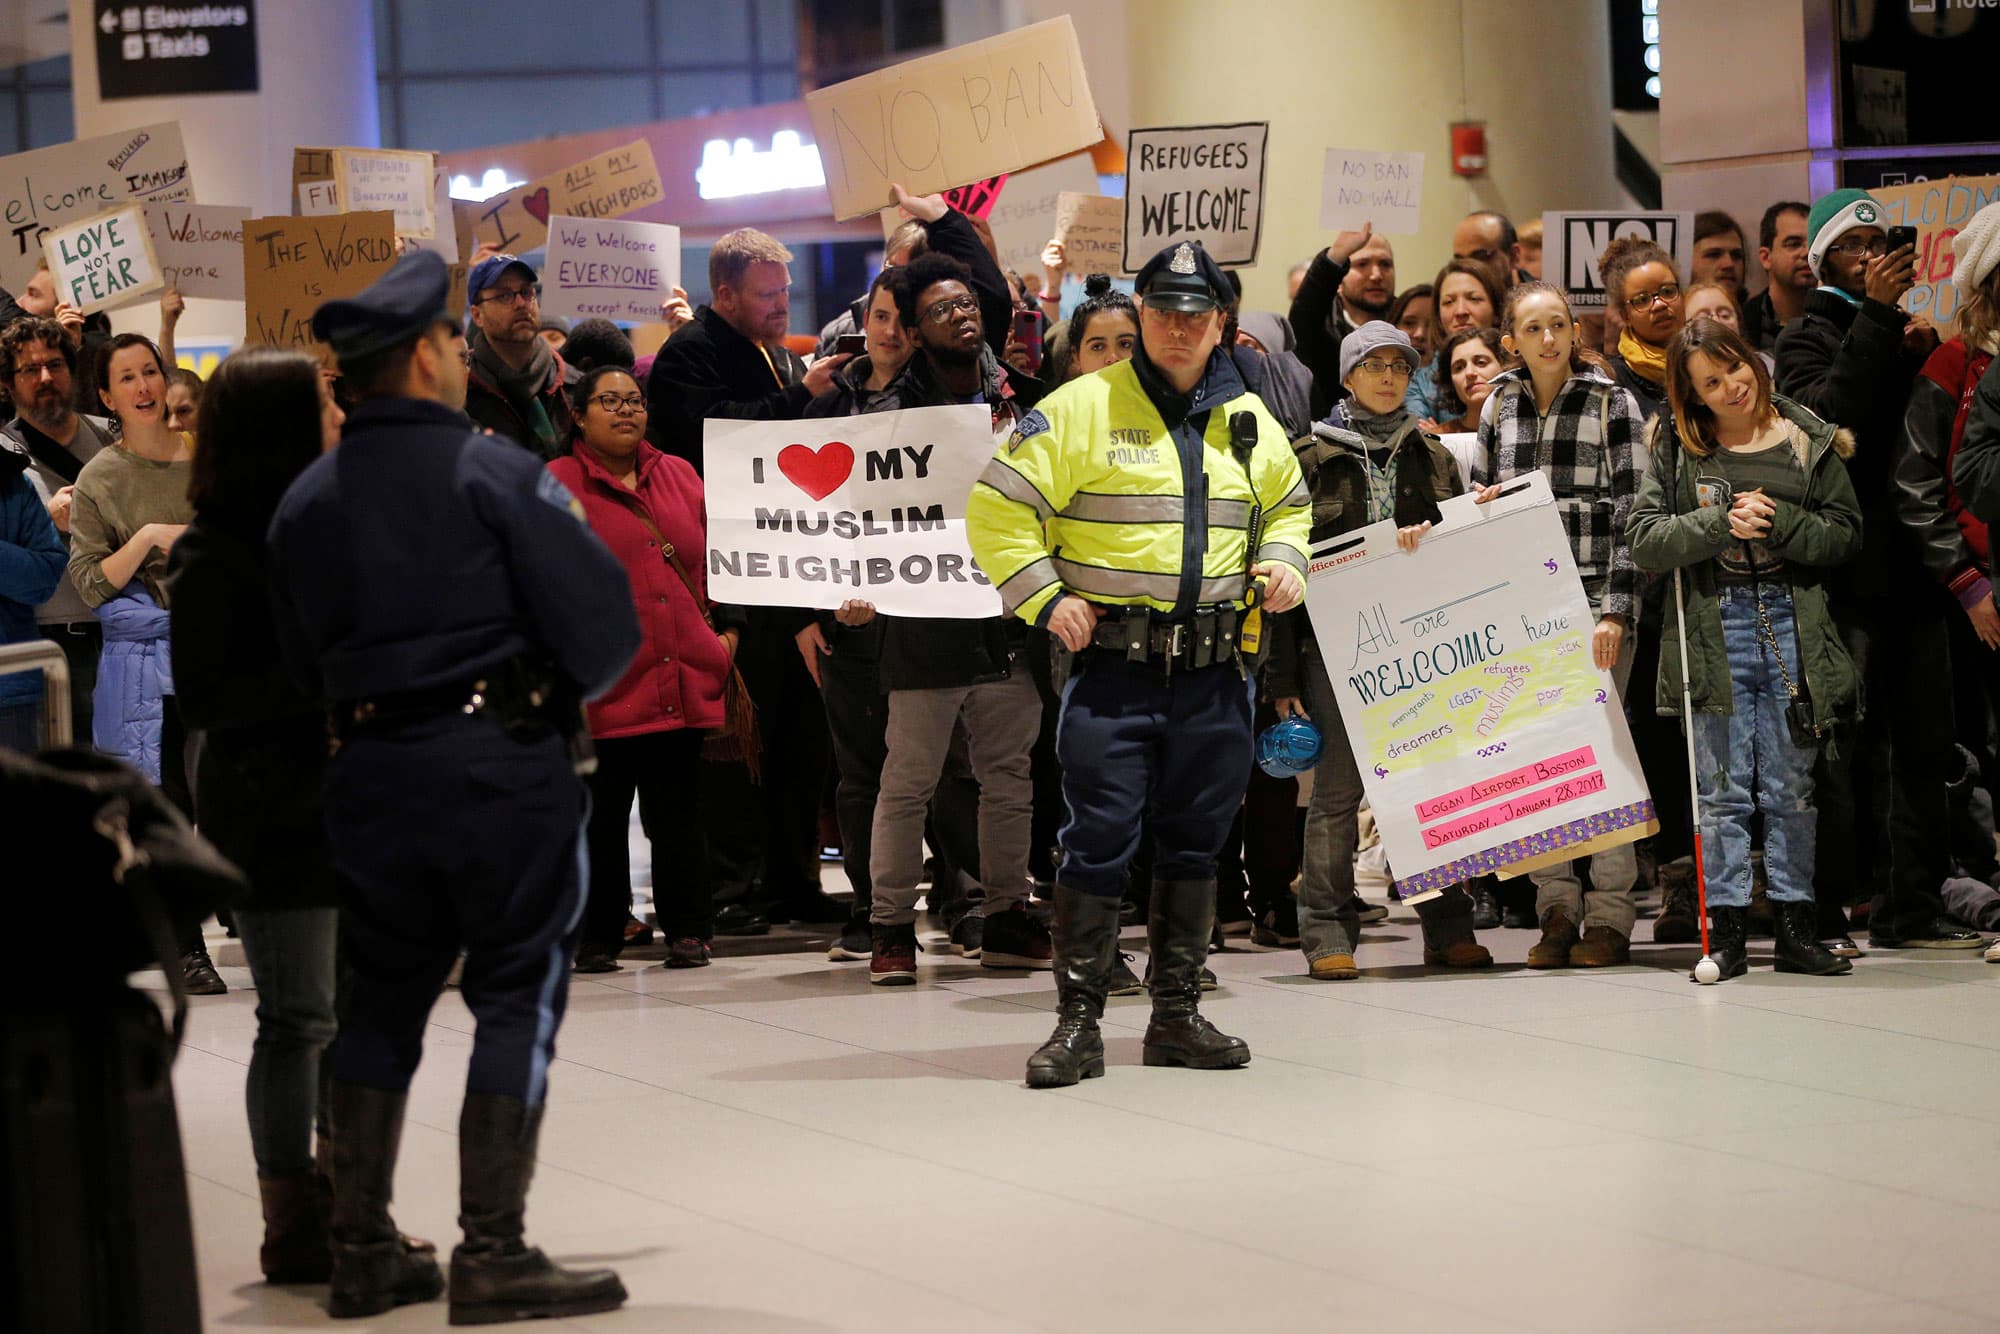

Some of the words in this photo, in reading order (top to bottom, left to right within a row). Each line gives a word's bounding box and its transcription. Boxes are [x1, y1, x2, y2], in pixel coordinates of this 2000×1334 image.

[144, 4, 248, 31] Elevators
[146, 34, 209, 59] Taxis
[832, 90, 941, 193] NO
[962, 61, 1074, 144] BAN
[565, 169, 597, 188] ALL
[608, 152, 634, 171] MY
[1140, 142, 1249, 172] REFUGEES
[1342, 160, 1366, 178] NO
[1374, 162, 1410, 180] BAN
[567, 178, 657, 218] NEIGHBORS
[1142, 186, 1251, 237] WELCOME
[1338, 187, 1362, 205] NO
[1371, 188, 1417, 209] WALL
[59, 218, 125, 265] LOVE
[164, 211, 243, 244] Welcome
[481, 200, 520, 249] I
[562, 230, 587, 249] We
[596, 231, 656, 252] Welcome
[84, 252, 111, 272] NOT
[256, 231, 306, 270] THE
[315, 224, 392, 273] WORLD
[70, 257, 140, 307] FEAR
[305, 283, 322, 297] IS
[560, 260, 659, 286] EVERYONE
[577, 302, 621, 317] except
[1110, 428, 1151, 446] STATE
[753, 457, 764, 484] I
[866, 444, 933, 482] MY
[1106, 447, 1160, 467] POLICE
[755, 504, 946, 539] MUSLIM
[710, 549, 990, 587] NEIGHBORS
[1336, 549, 1367, 565] DEPOT
[1348, 602, 1398, 671] All
[1413, 610, 1449, 638] are
[1349, 624, 1504, 705] WELCOME
[1521, 614, 1569, 642] here
[1483, 662, 1531, 676] refugees
[1475, 675, 1525, 738] muslims
[1536, 685, 1564, 708] poor
[1387, 722, 1454, 759] dreamers
[1419, 797, 1465, 819] LOGAN
[1535, 755, 1586, 782] BOSTON
[1499, 797, 1551, 823] JANUARY
